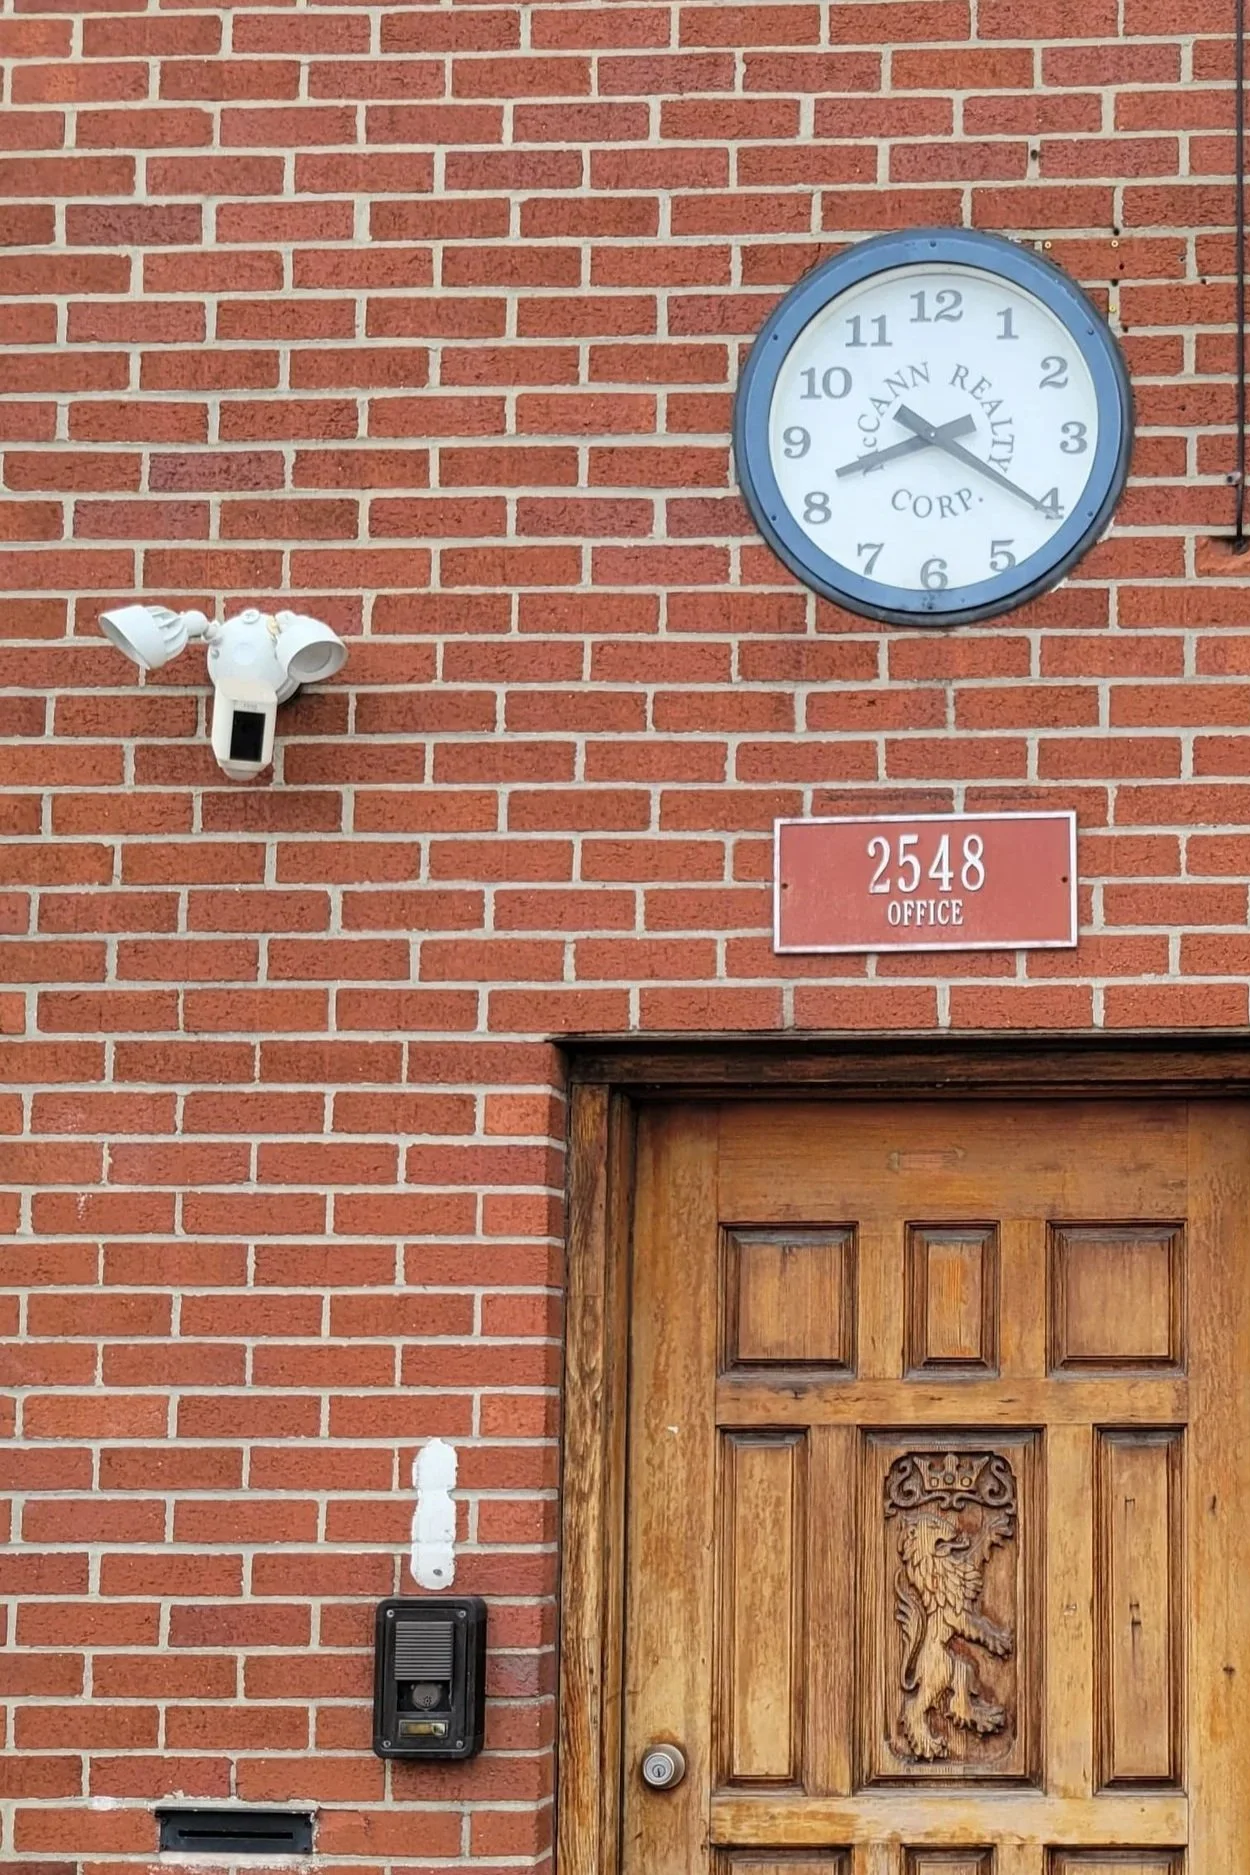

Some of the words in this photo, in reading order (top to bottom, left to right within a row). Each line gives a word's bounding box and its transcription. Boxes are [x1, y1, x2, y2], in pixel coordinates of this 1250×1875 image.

[909, 289, 963, 323] 12
[844, 314, 893, 347] 11
[995, 307, 1019, 340] 1
[800, 366, 852, 399] 10
[1038, 355, 1068, 389] 2
[949, 362, 1015, 474] REALTY
[782, 426, 811, 459] 9
[1059, 420, 1088, 454] 3
[802, 491, 832, 525] 8
[890, 486, 984, 519] CORP.
[1034, 486, 1064, 520] 4
[857, 542, 884, 576] 7
[989, 539, 1016, 573] 5
[920, 558, 949, 590] 6
[867, 833, 986, 894] 2548
[887, 899, 964, 926] OFFICE
